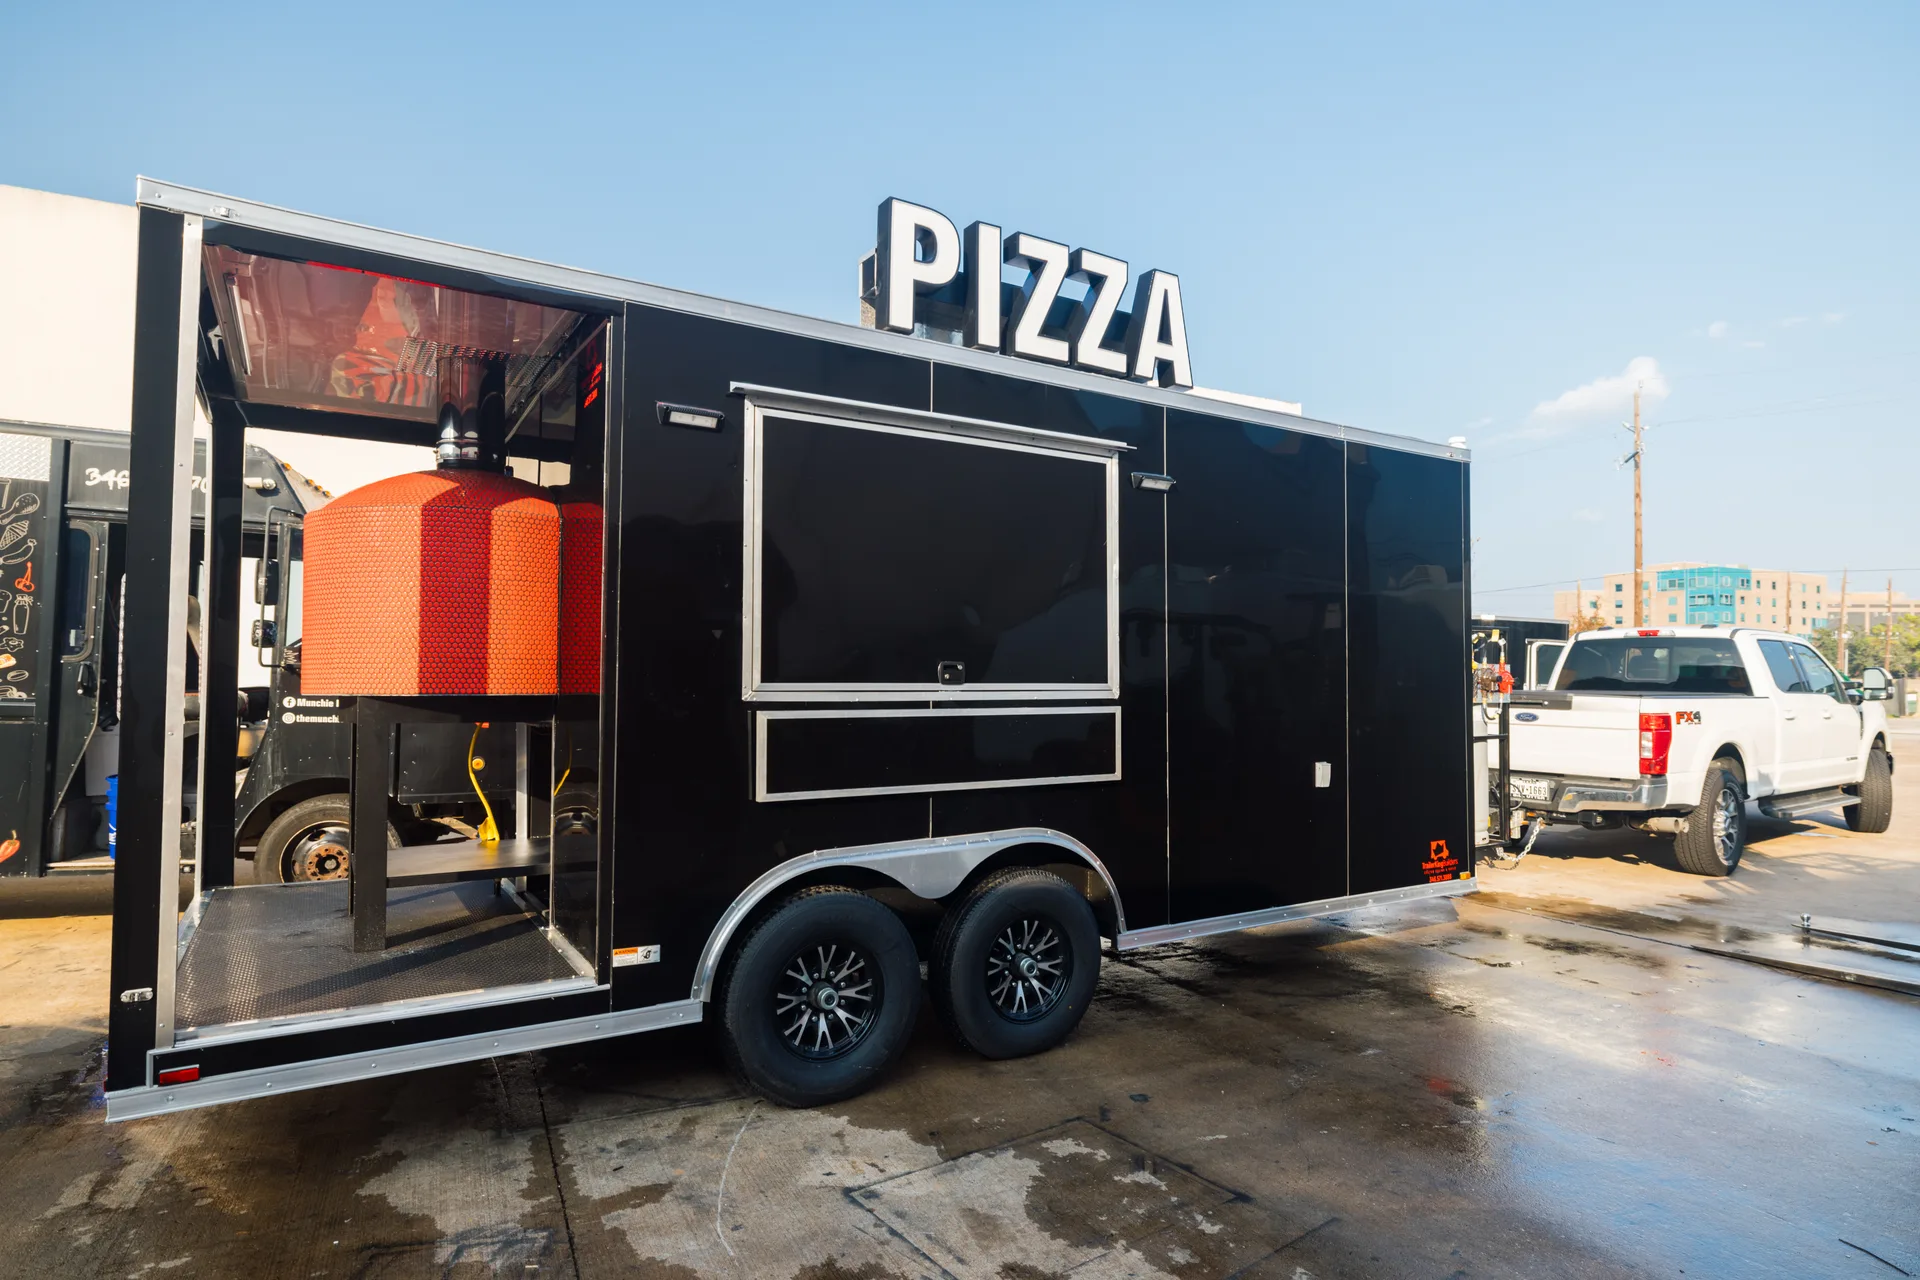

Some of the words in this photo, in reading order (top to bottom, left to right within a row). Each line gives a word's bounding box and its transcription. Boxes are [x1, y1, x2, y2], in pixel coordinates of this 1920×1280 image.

[878, 196, 1194, 388] PIZZA
[85, 468, 129, 490] 346
[296, 698, 334, 707] Munchie
[295, 713, 340, 723] themunch
[1675, 711, 1701, 724] FX4
